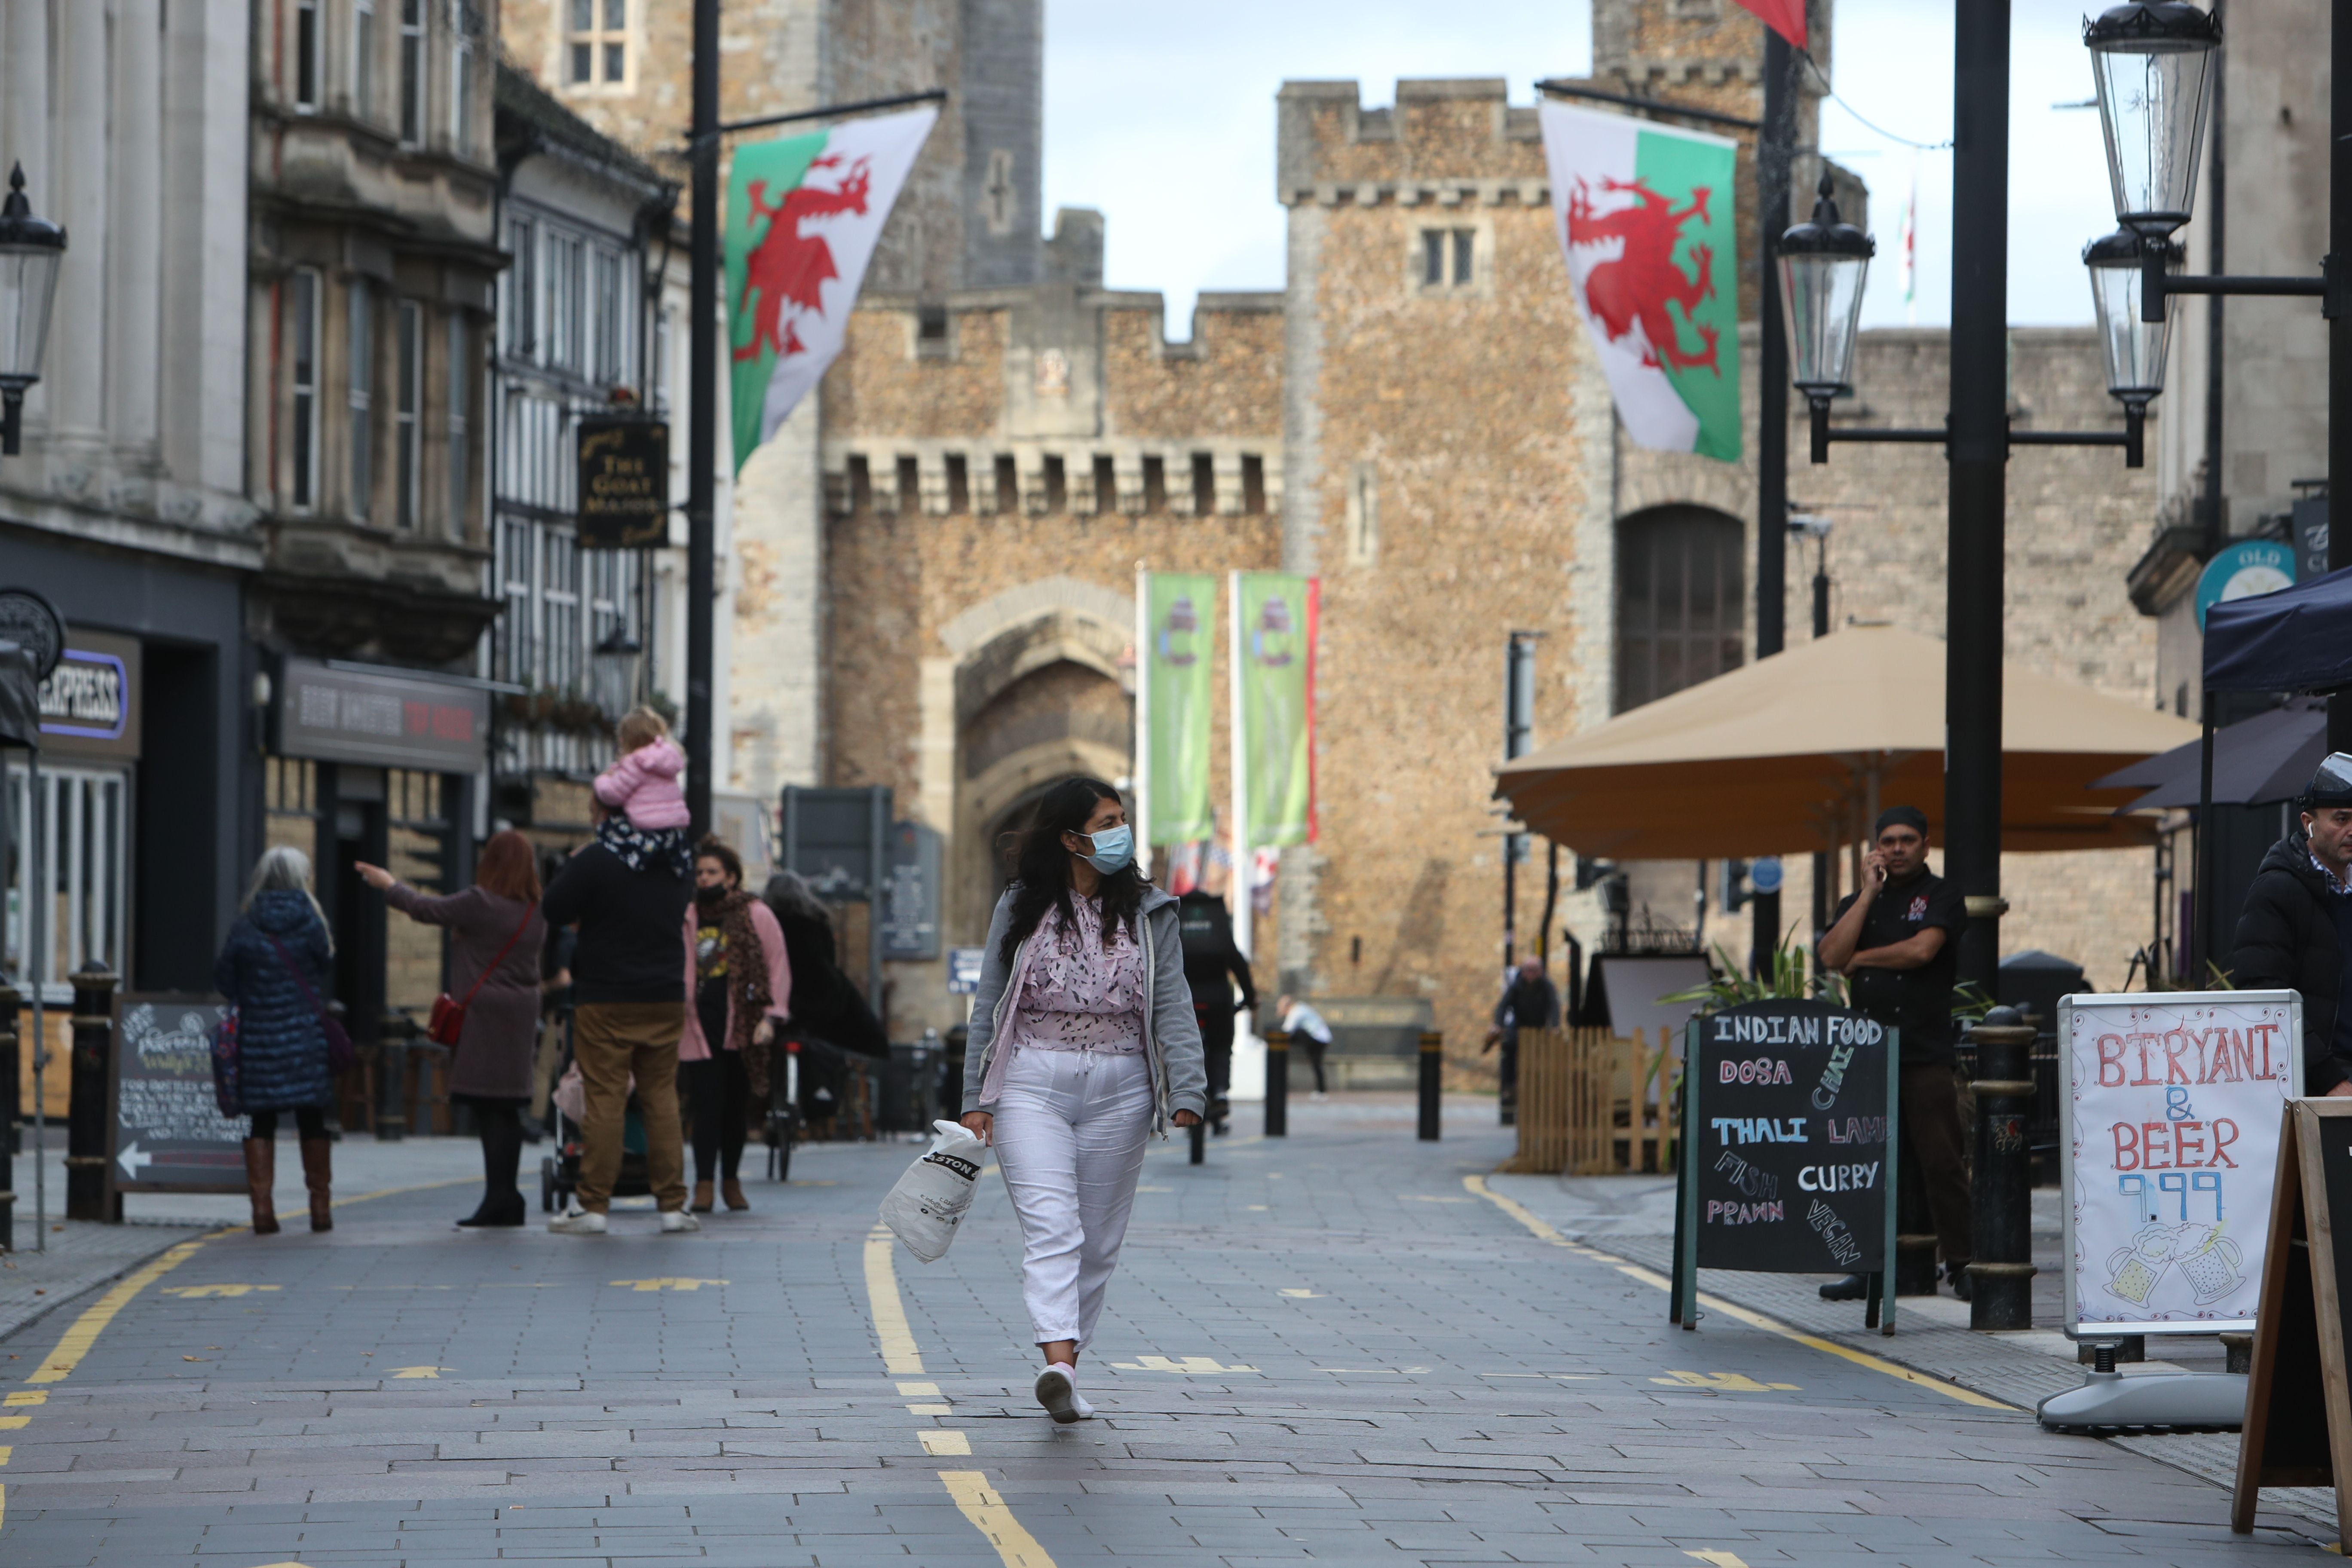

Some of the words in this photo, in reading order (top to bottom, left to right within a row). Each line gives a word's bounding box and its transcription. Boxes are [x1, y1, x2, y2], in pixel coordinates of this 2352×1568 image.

[1714, 1015, 1819, 1044] INDIAN
[1827, 1016, 1882, 1045] FOOD
[1719, 1057, 1793, 1086] DOSA
[2092, 1024, 2278, 1087] BIRYANI
[1811, 1044, 1854, 1110] CHAI
[2166, 1086, 2195, 1121] &
[1711, 1118, 1809, 1145] THALI
[2107, 1118, 2239, 1171] BEER
[928, 1154, 972, 1175] ASTON
[1714, 1150, 1779, 1200] FISH
[1798, 1161, 1880, 1193] CURRY
[1707, 1200, 1784, 1225] PRAWN
[2118, 1172, 2222, 1222] 9.99
[1807, 1198, 1862, 1267] VEGAN
